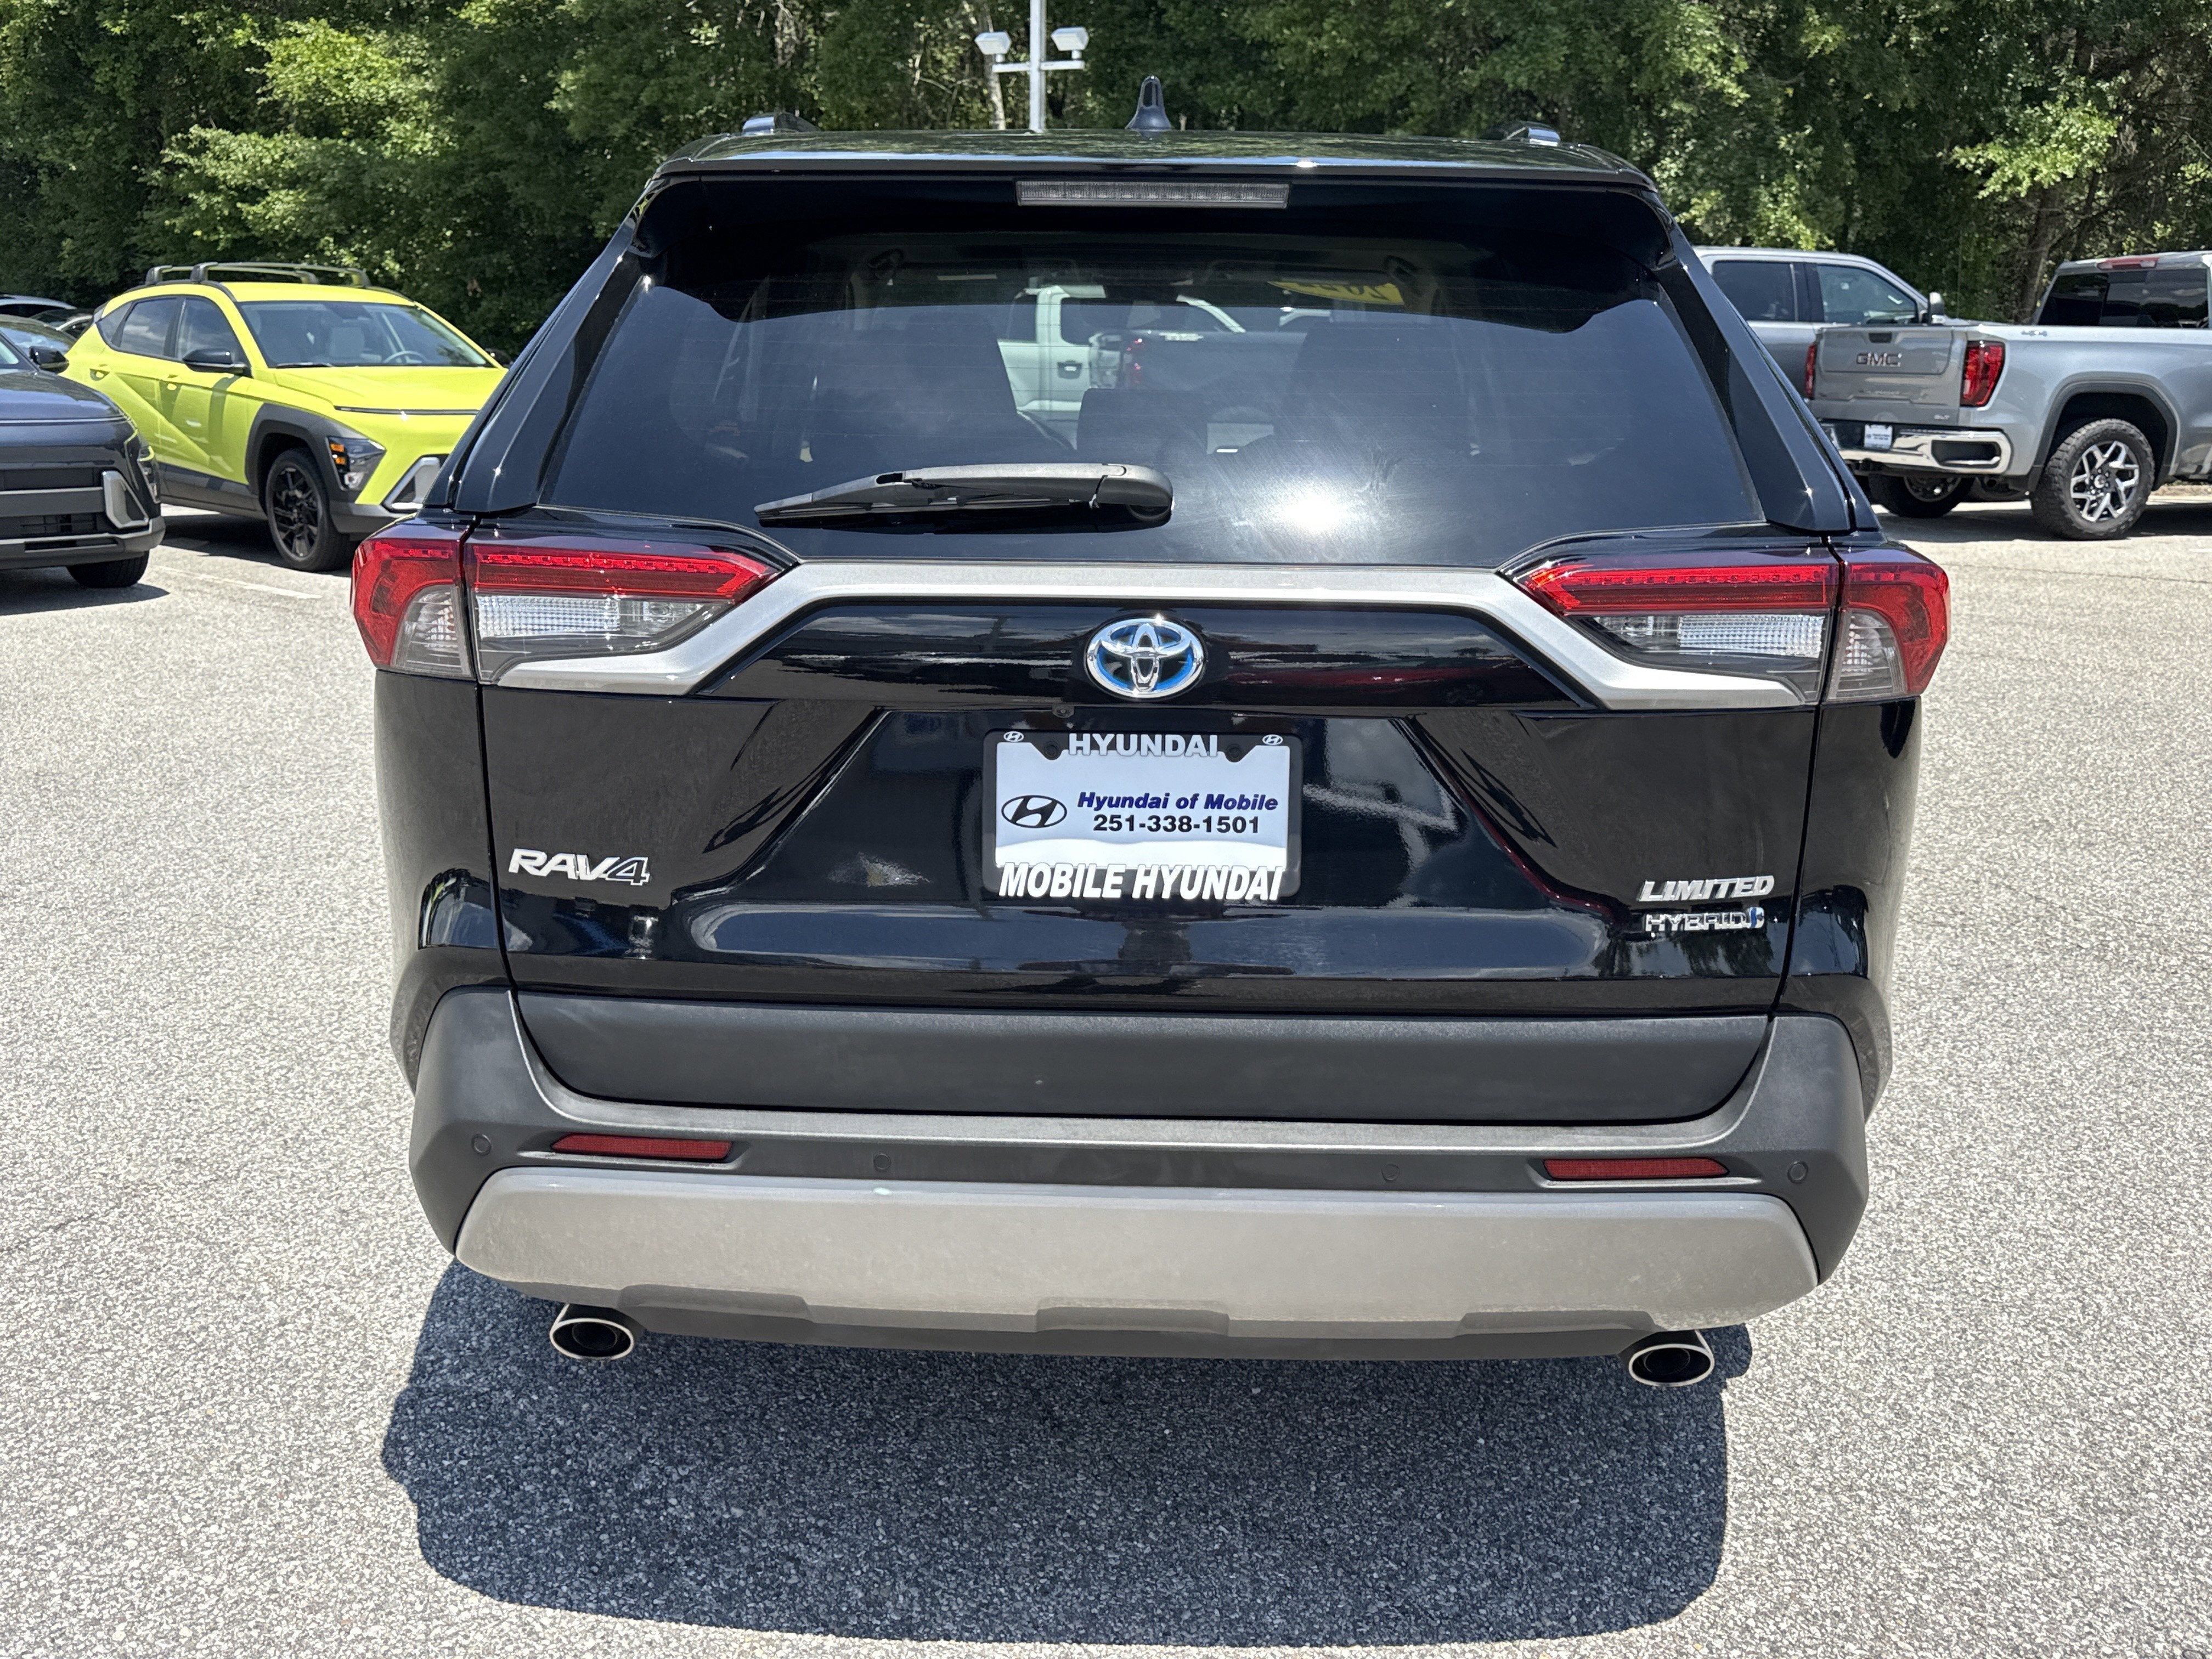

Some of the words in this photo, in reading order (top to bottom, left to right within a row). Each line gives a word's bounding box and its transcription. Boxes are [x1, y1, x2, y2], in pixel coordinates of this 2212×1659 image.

[1857, 352, 1901, 367] GMC
[1068, 733, 1217, 757] HYUNDAI
[1077, 792, 1170, 811] Hyundai
[1176, 793, 1200, 809] of
[1204, 795, 1278, 810] Mobile
[1093, 814, 1259, 833] 251-338-1501
[508, 848, 651, 885] RAV4
[999, 862, 1126, 898] MOBILE
[1132, 865, 1285, 900] HYUNDAI
[1638, 875, 1774, 902] LIMITED
[1645, 912, 1747, 931] HYBRID
